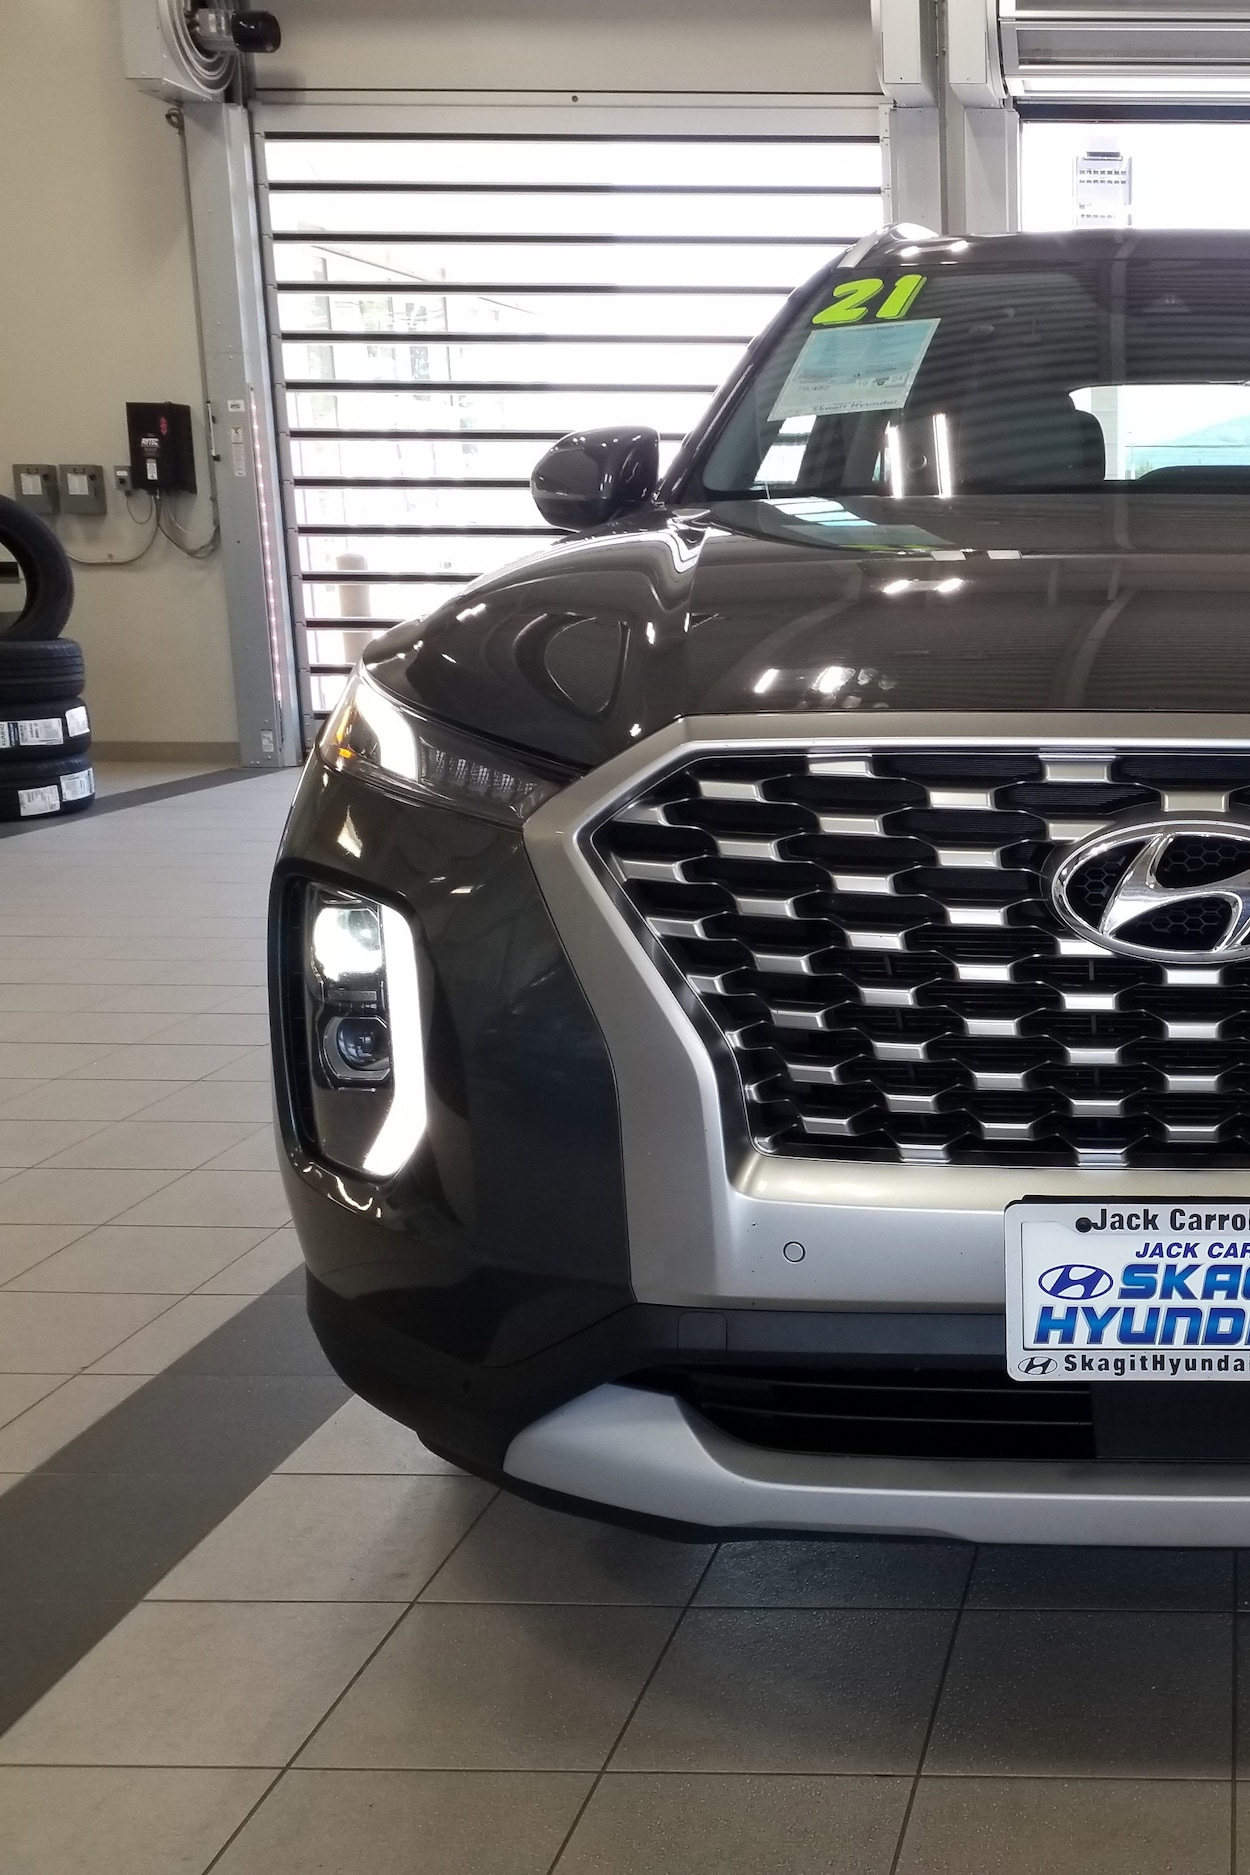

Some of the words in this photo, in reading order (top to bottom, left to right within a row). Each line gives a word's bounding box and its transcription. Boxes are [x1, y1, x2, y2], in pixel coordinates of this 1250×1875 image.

[812, 274, 927, 325] 21
[1091, 1208, 1160, 1231] Jack
[1135, 1242, 1200, 1259] JACK
